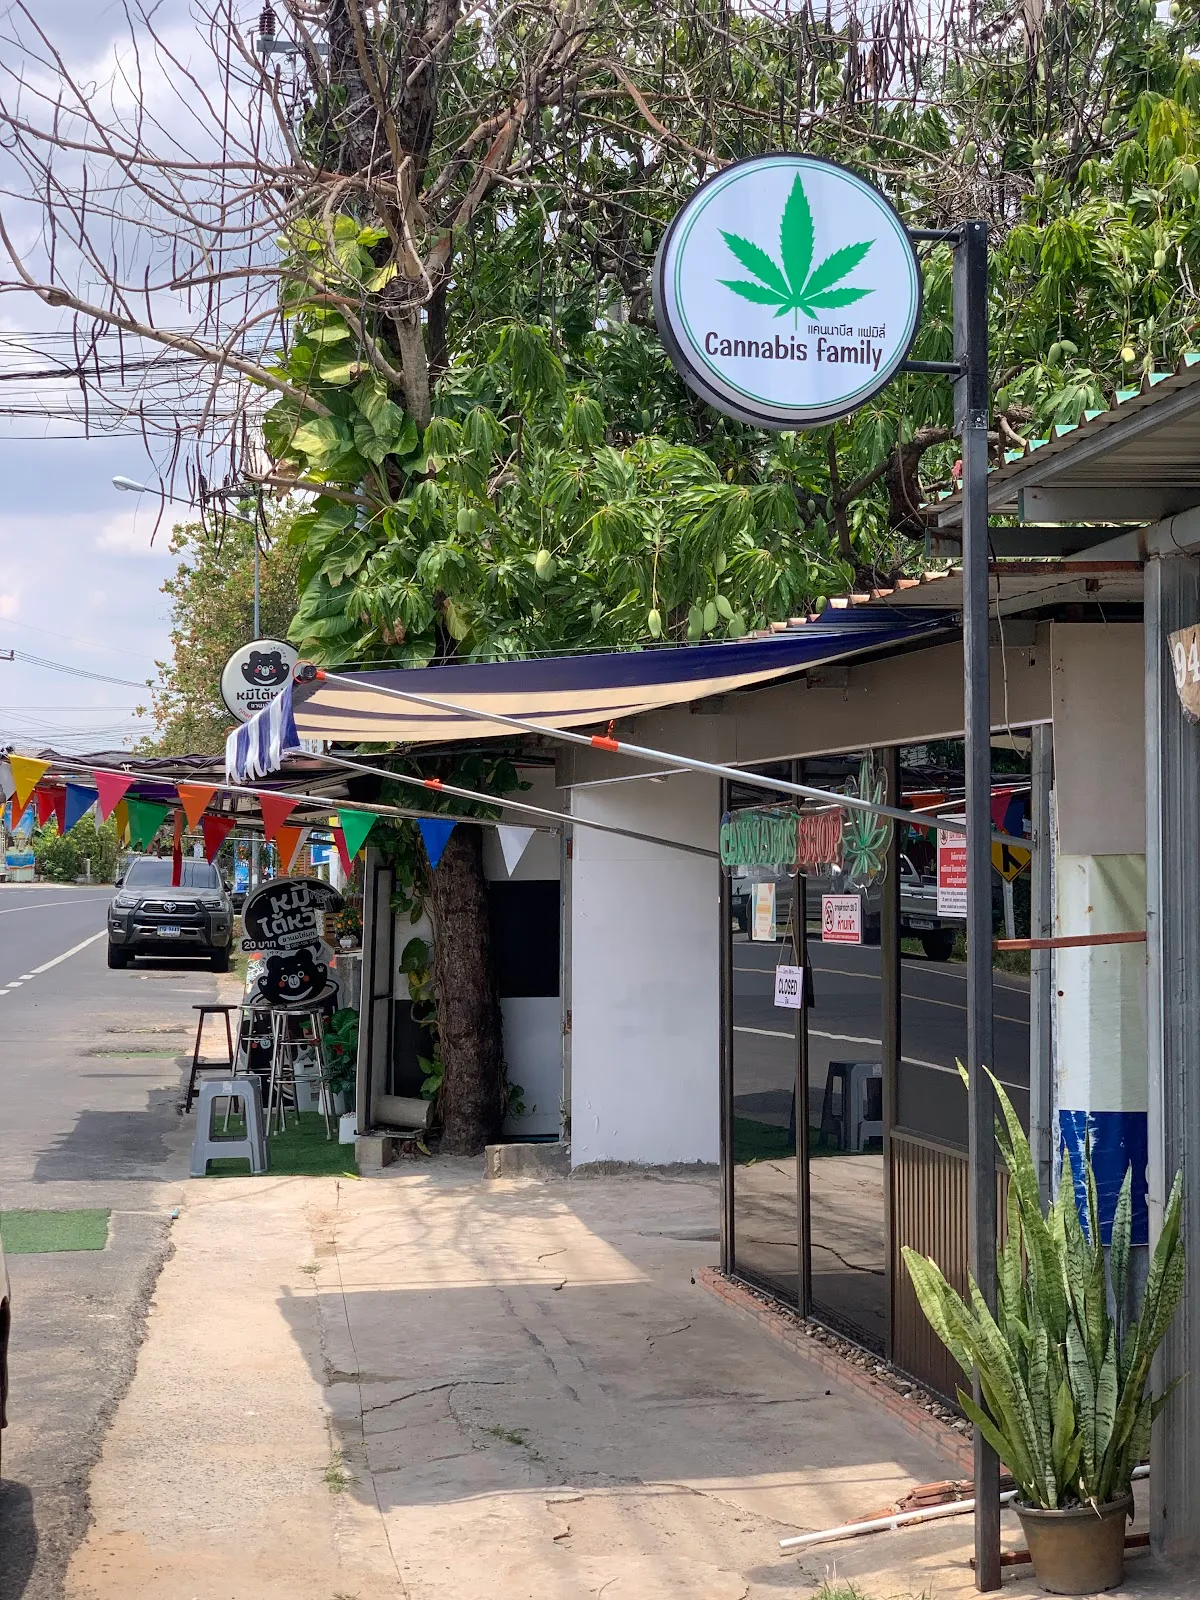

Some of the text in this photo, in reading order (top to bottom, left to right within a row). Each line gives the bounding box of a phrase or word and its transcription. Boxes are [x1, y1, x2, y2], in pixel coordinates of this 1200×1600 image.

[808, 323, 886, 339] แคนนาบีส แฟมิลี่
[705, 332, 883, 372] Cannabis family
[721, 814, 843, 866] CANNABIS SHOP
[270, 882, 310, 913] หมี
[256, 907, 316, 938] ไต้หวั
[243, 940, 277, 949] 20 บาท
[778, 978, 798, 996] CLOSED
